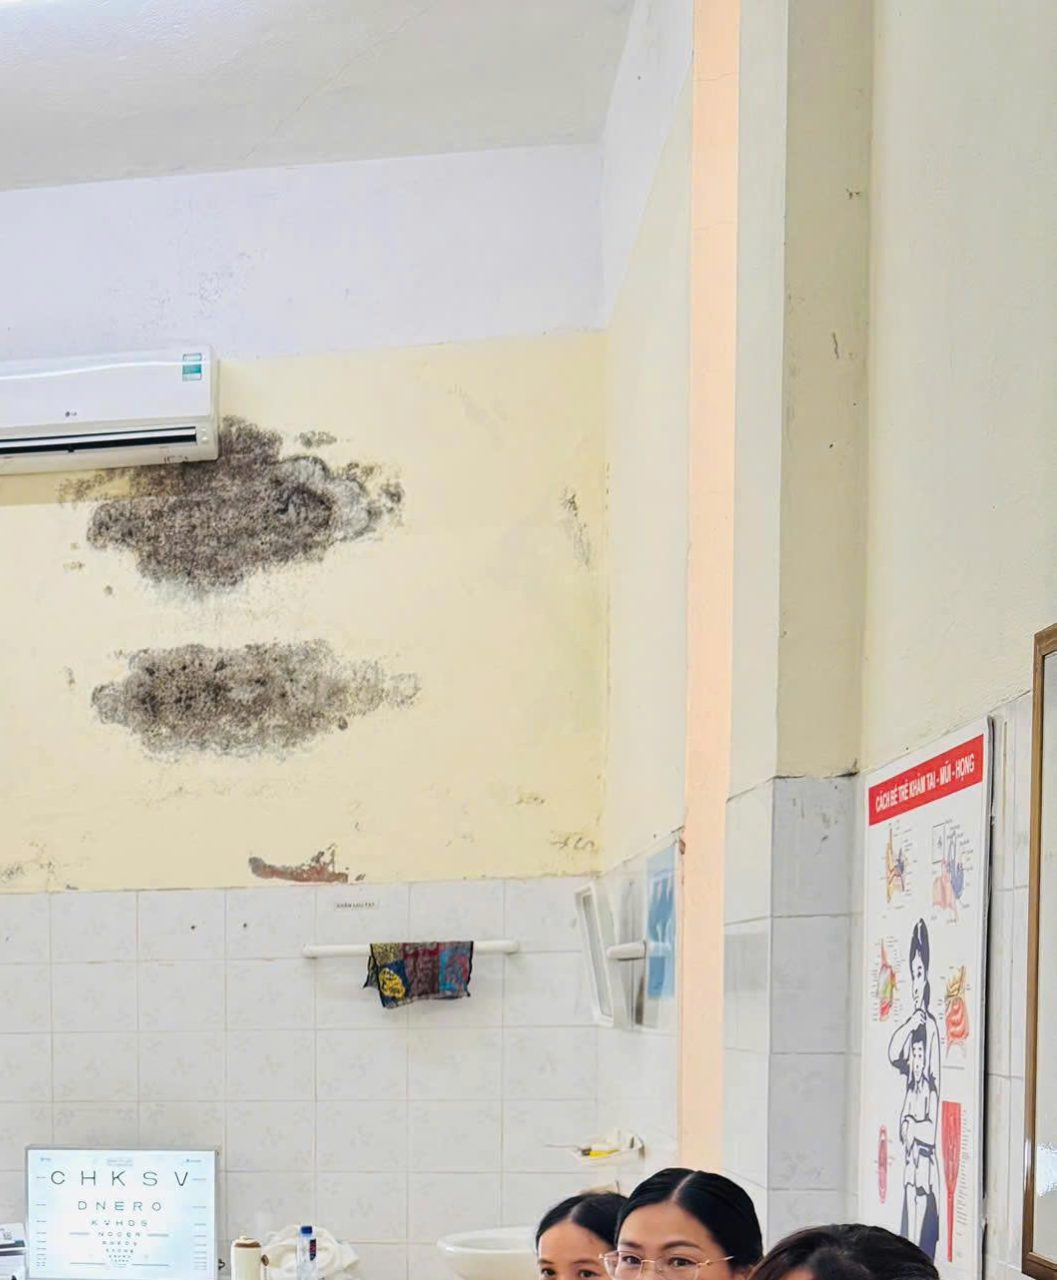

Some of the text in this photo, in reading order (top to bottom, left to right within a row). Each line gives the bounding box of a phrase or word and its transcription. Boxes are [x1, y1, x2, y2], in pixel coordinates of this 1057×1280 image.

[875, 789, 890, 813] CÁCH
[909, 772, 926, 799] KHÁM
[926, 770, 936, 791] TAI
[939, 760, 952, 786] MŨI
[955, 753, 975, 781] HỌNG
